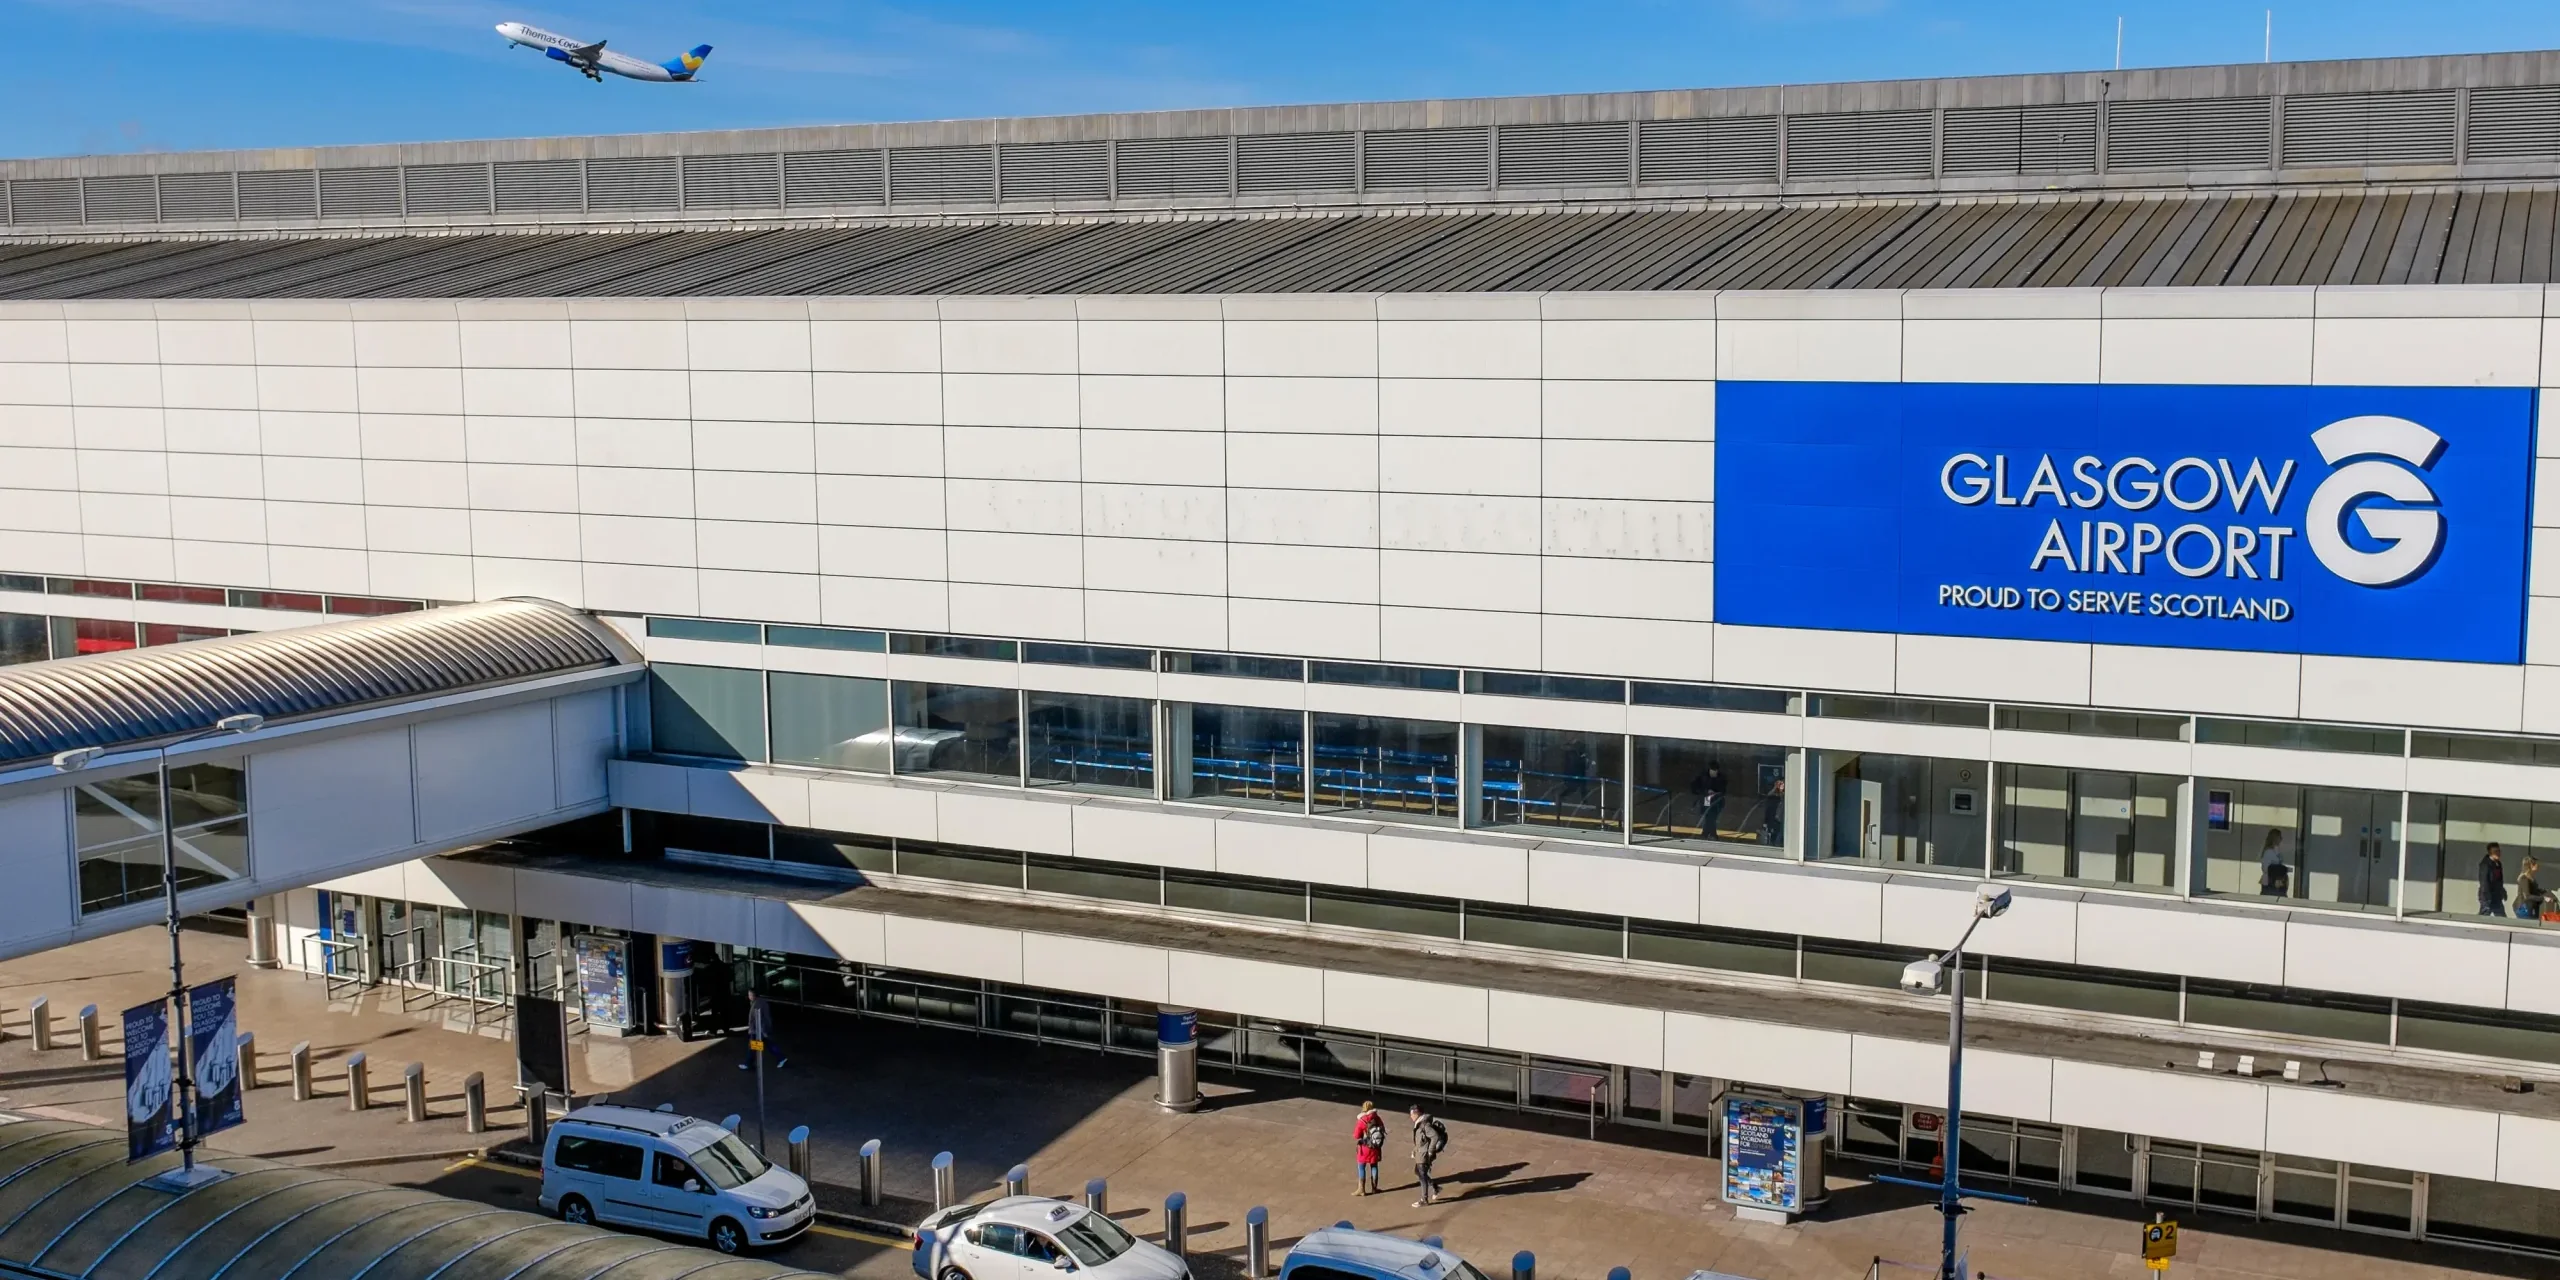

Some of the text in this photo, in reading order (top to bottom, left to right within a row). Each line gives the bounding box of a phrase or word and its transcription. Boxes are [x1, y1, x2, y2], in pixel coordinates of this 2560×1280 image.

[521, 26, 556, 44] Thomas
[1941, 453, 2294, 514] GLASGOW
[2030, 518, 2293, 579] AIRPORT
[1939, 584, 2290, 621] PROUD TO SERVE SCOTLAND
[192, 996, 211, 1006] PROUD
[193, 1001, 222, 1013] WELCOME
[193, 1009, 215, 1021] YOU TO
[193, 1014, 224, 1028] GLASGOW
[126, 1015, 153, 1029] PROUD TO
[126, 1023, 154, 1036] WELCOME
[126, 1034, 140, 1043] YOU
[127, 1037, 156, 1051] GLASGOW
[673, 1117, 694, 1130] TAXI
[1740, 1130, 1768, 1138] SCOTLAND
[1740, 1135, 1772, 1144] WORLDWIDE
[1050, 1204, 1068, 1216] TAXI
[2165, 1225, 2174, 1240] 2
